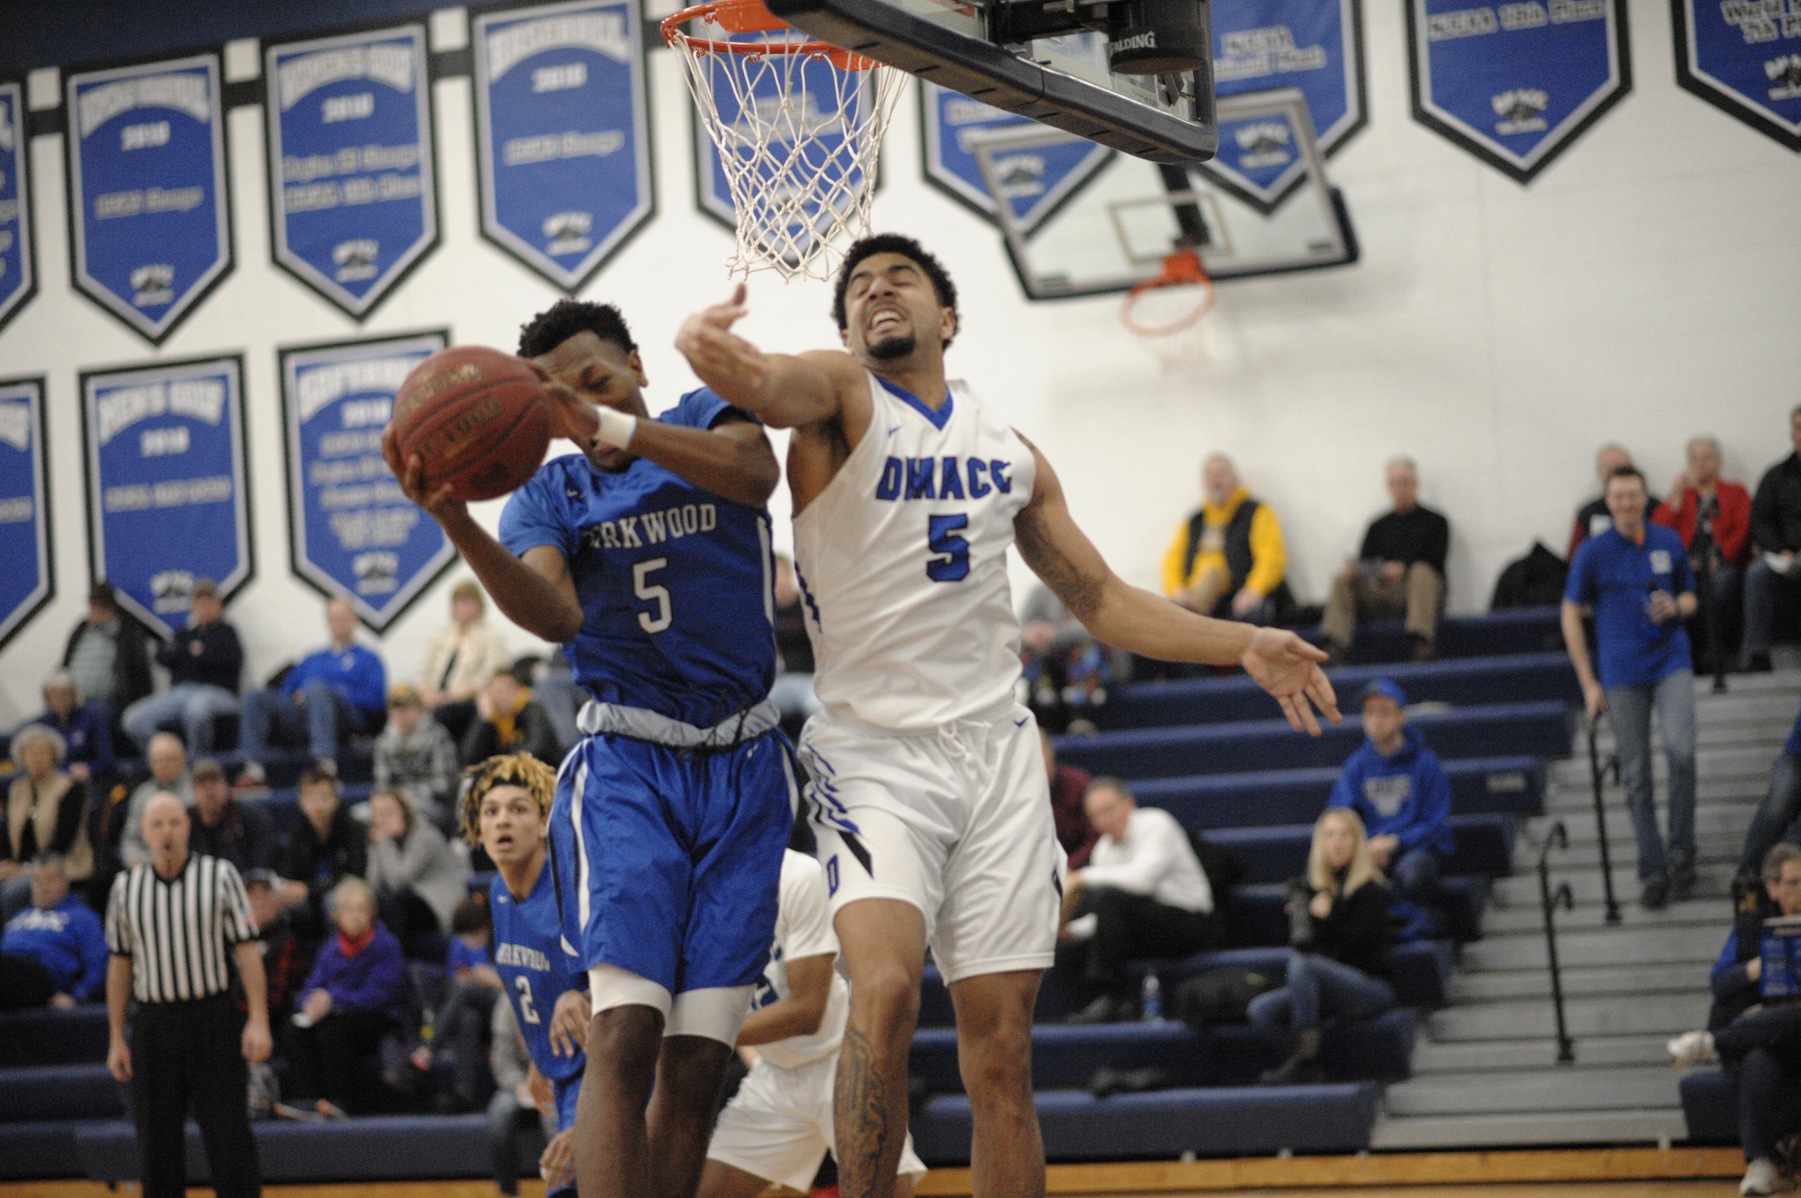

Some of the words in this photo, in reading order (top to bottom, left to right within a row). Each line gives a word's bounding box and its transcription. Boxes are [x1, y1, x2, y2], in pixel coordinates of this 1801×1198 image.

[876, 456, 1012, 501] DMACC
[926, 513, 971, 582] 5
[633, 557, 673, 634] 5
[514, 974, 541, 1025] 2
